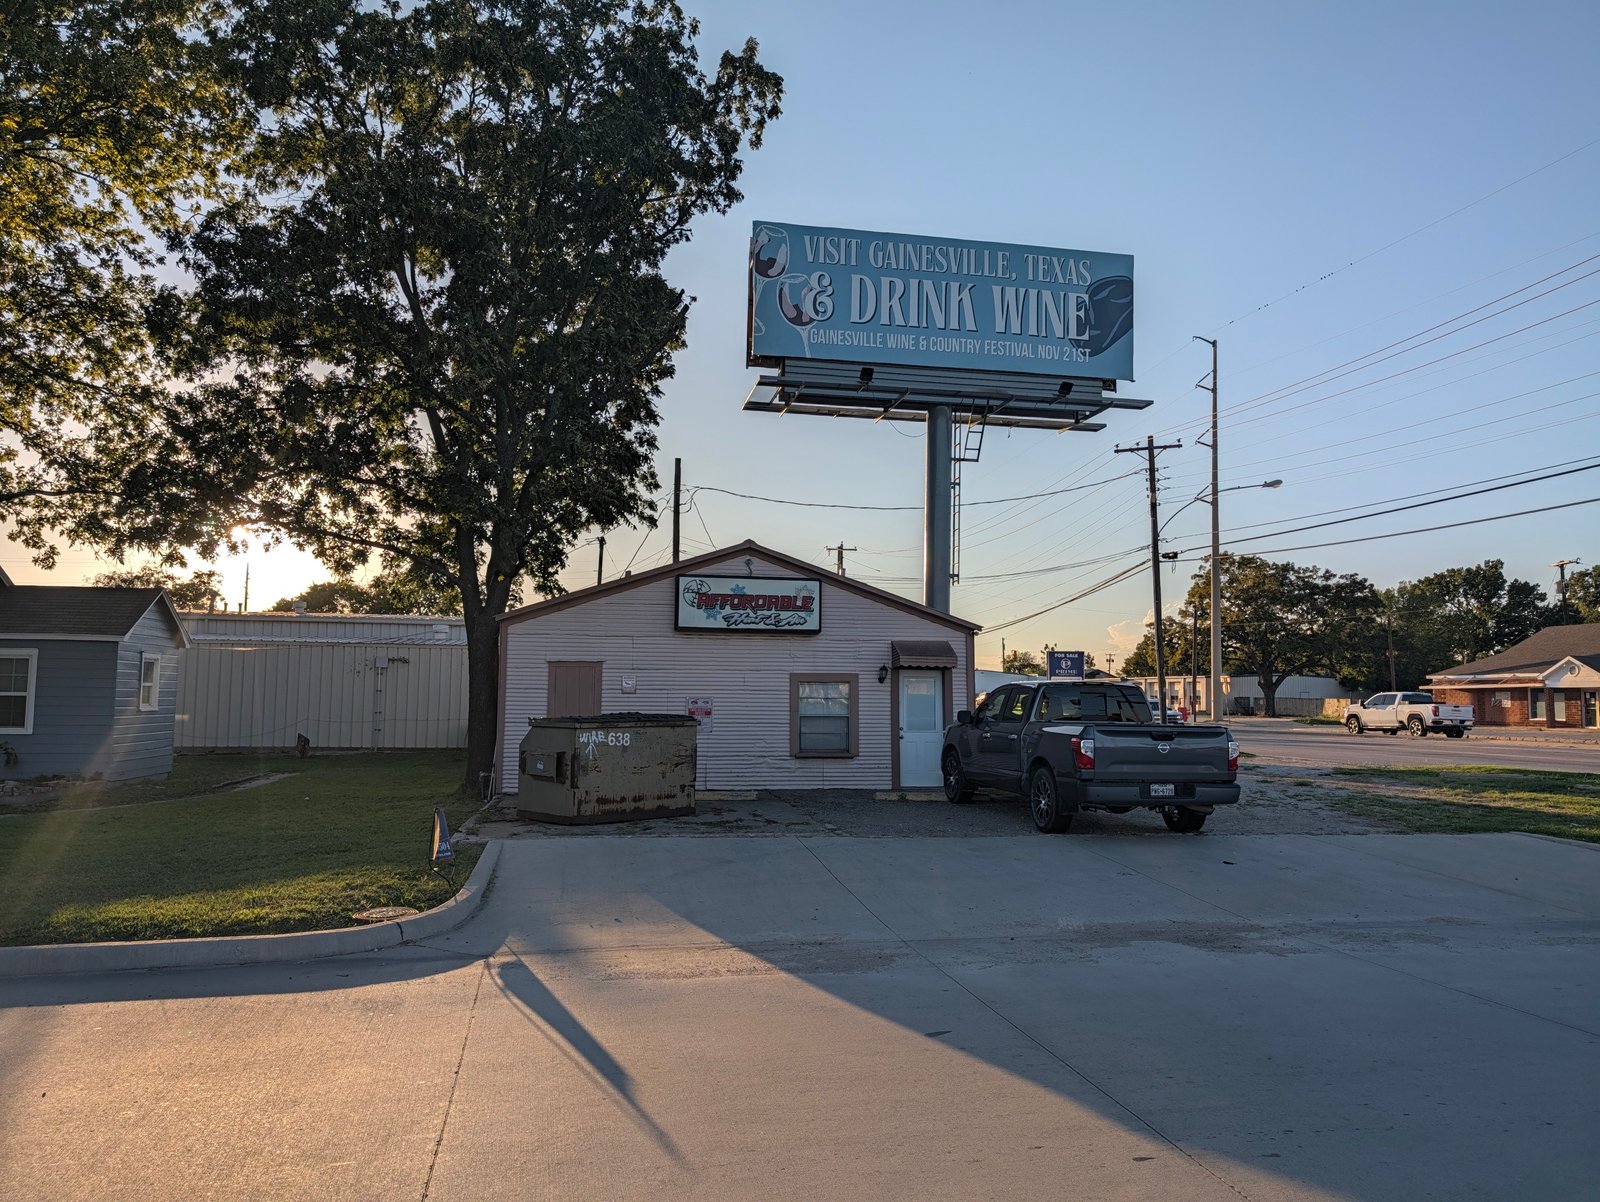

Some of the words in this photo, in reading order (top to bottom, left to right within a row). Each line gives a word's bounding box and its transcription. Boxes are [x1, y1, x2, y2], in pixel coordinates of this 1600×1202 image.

[804, 235, 862, 266] VISIT
[868, 241, 1018, 281] GAINESVILLE,
[1024, 253, 1092, 287] TEXAS
[805, 271, 835, 321] &
[850, 274, 978, 333] DRINK
[992, 285, 1090, 341] WINE
[810, 329, 883, 348] GAINESVILLE
[887, 333, 915, 350] WINE
[919, 335, 927, 350] &
[929, 336, 981, 354] COUNTRY
[984, 339, 1035, 358] FESTIVAL
[1038, 344, 1060, 360] NOV
[1063, 347, 1092, 363] 21ST
[696, 593, 815, 613] AFFORDABLE
[608, 732, 630, 746] 638
